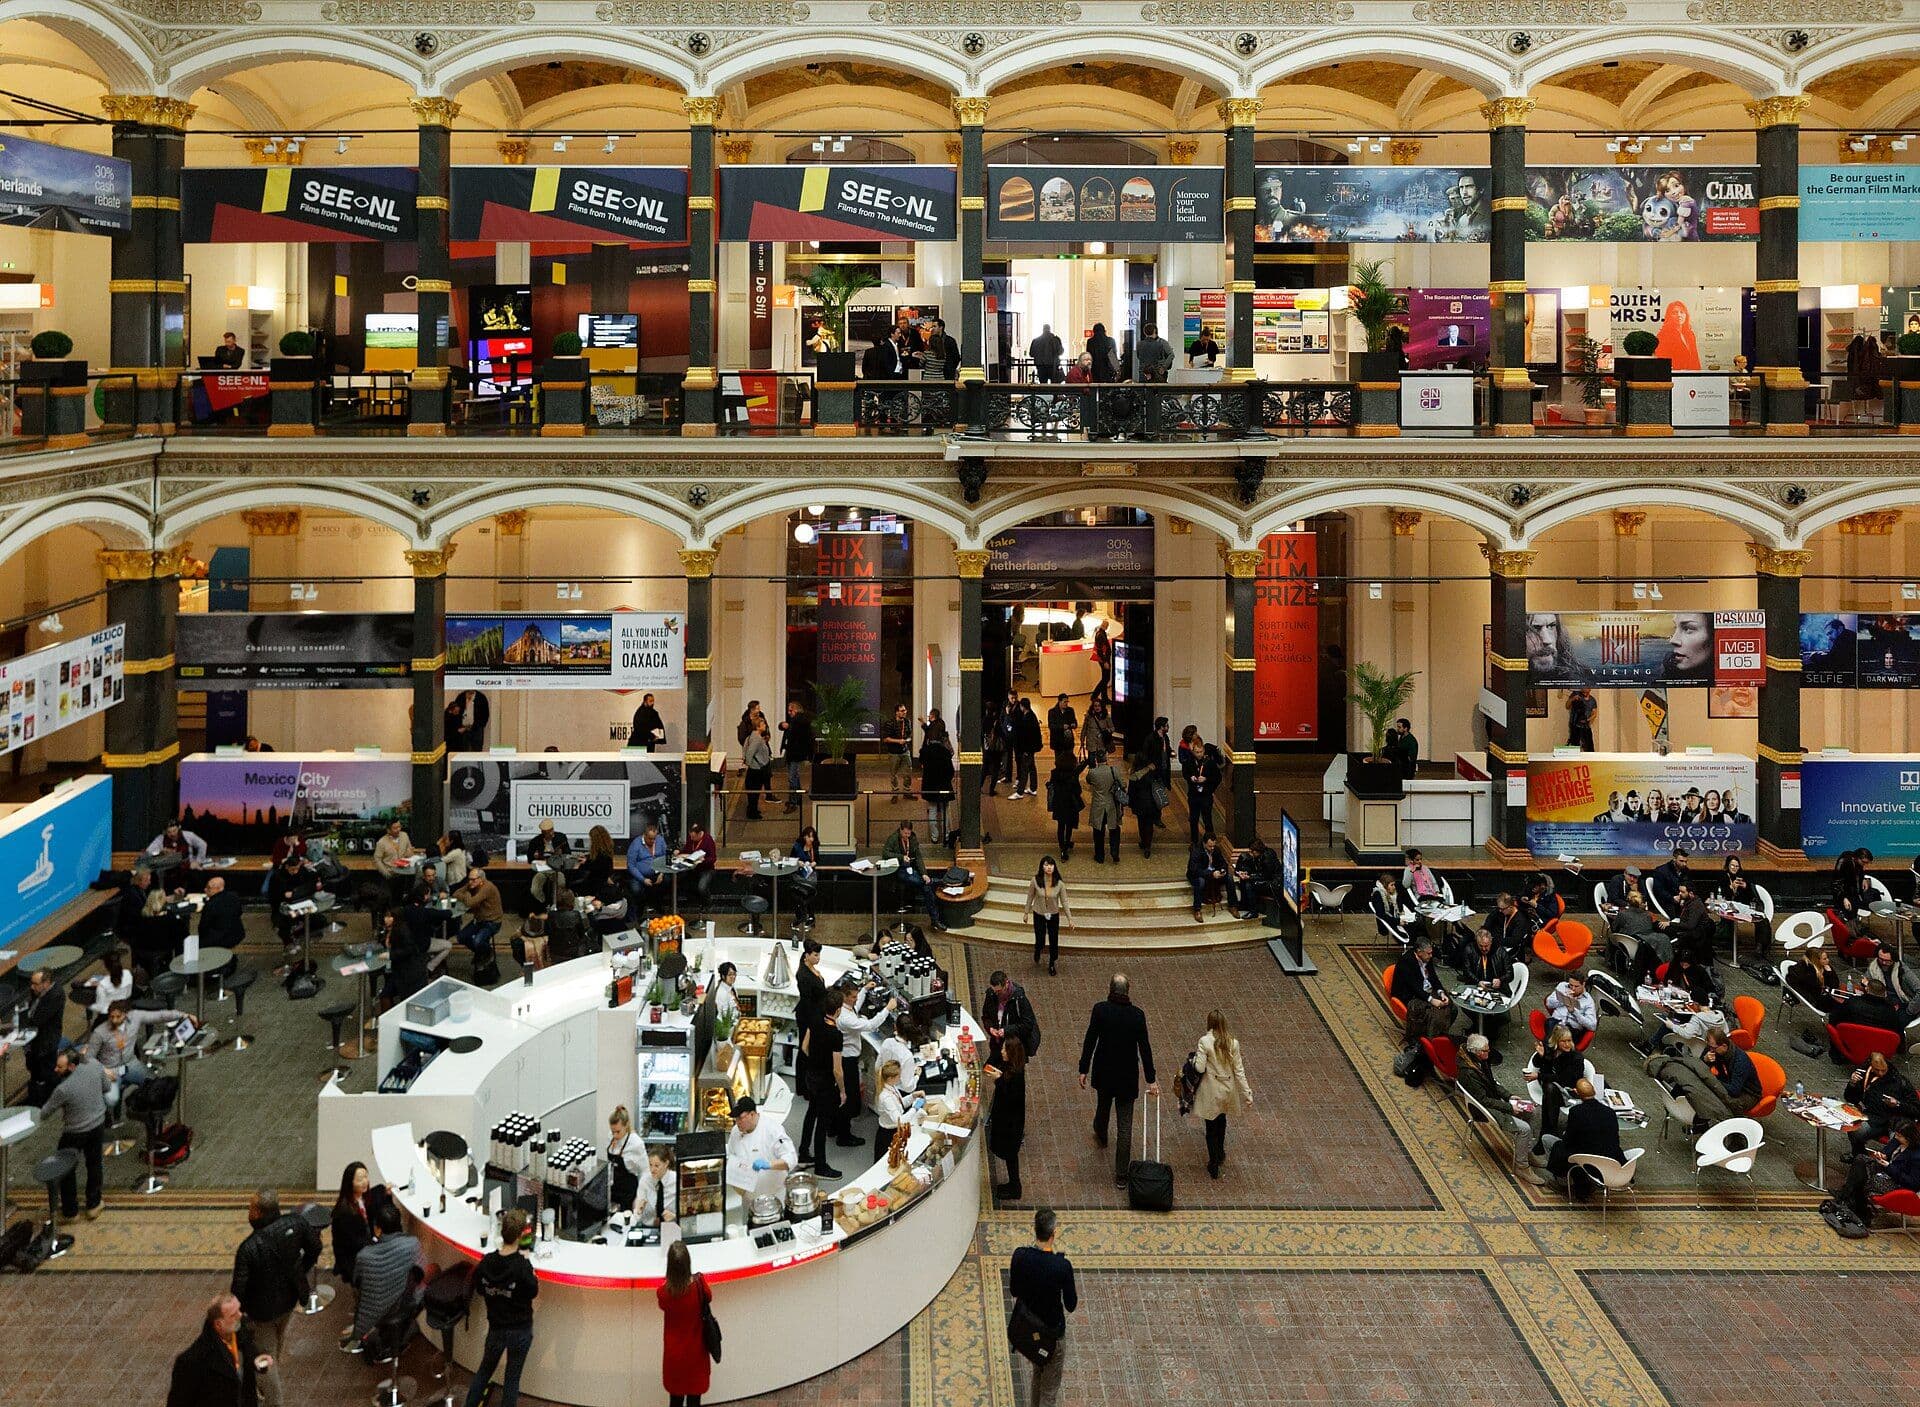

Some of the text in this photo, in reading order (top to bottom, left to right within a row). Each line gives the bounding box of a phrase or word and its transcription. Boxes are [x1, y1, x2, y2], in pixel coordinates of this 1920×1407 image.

[94, 164, 116, 180] 30%
[1830, 174, 1844, 183] Be
[1864, 174, 1894, 185] guest
[1895, 173, 1910, 183] in
[94, 180, 116, 194] cash
[1807, 184, 1824, 194] the
[1826, 184, 1867, 194] German
[1868, 184, 1890, 194] Film
[303, 180, 401, 222] SEE NL
[841, 180, 938, 222] SEE NL
[1176, 191, 1210, 199] Morocco
[94, 194, 121, 209] rebate
[572, 180, 669, 223] SEE NL
[1176, 199, 1195, 207] your
[1176, 205, 1195, 214] ideal
[300, 203, 399, 233] Films from The Netherlands
[568, 202, 667, 234] Films from The Netherlands
[837, 202, 936, 233] Films from The Netherlands
[1176, 214, 1208, 222] location
[756, 277, 767, 293] De
[1610, 309, 1647, 322] MRS
[817, 537, 865, 560] LUX
[988, 538, 1016, 548] take
[1106, 539, 1132, 550] 30%
[1106, 551, 1132, 560] cash
[817, 561, 874, 583] FILM
[990, 561, 1058, 571] netherlands
[1107, 561, 1141, 571] rebate
[1255, 585, 1318, 606] PRIZE
[822, 621, 867, 630] BRINGING
[1259, 621, 1312, 630] SUBTITLING
[92, 626, 124, 646] MEXICO
[621, 628, 669, 637] ALL YOU NEED
[822, 632, 877, 641] FILMS FROM
[1259, 632, 1285, 641] FILMS
[246, 645, 297, 653] Challenging
[622, 640, 668, 649] TO FILM IS IN
[822, 643, 871, 652] EUROPE TO
[1724, 641, 1756, 653] MGB
[622, 652, 668, 668] OAXACA
[822, 654, 876, 663] EUROPEANS
[1726, 656, 1753, 668] 105
[1805, 674, 1844, 684] SELFIE
[1866, 675, 1886, 683] DARK
[245, 772, 331, 788] Mexico City
[1531, 765, 1591, 786] POWER TO
[274, 789, 368, 799] city of contrasts
[1533, 779, 1594, 806] CHANGE
[528, 803, 612, 817] CHURUBUSCO
[1841, 801, 1920, 813] Innovative Te
